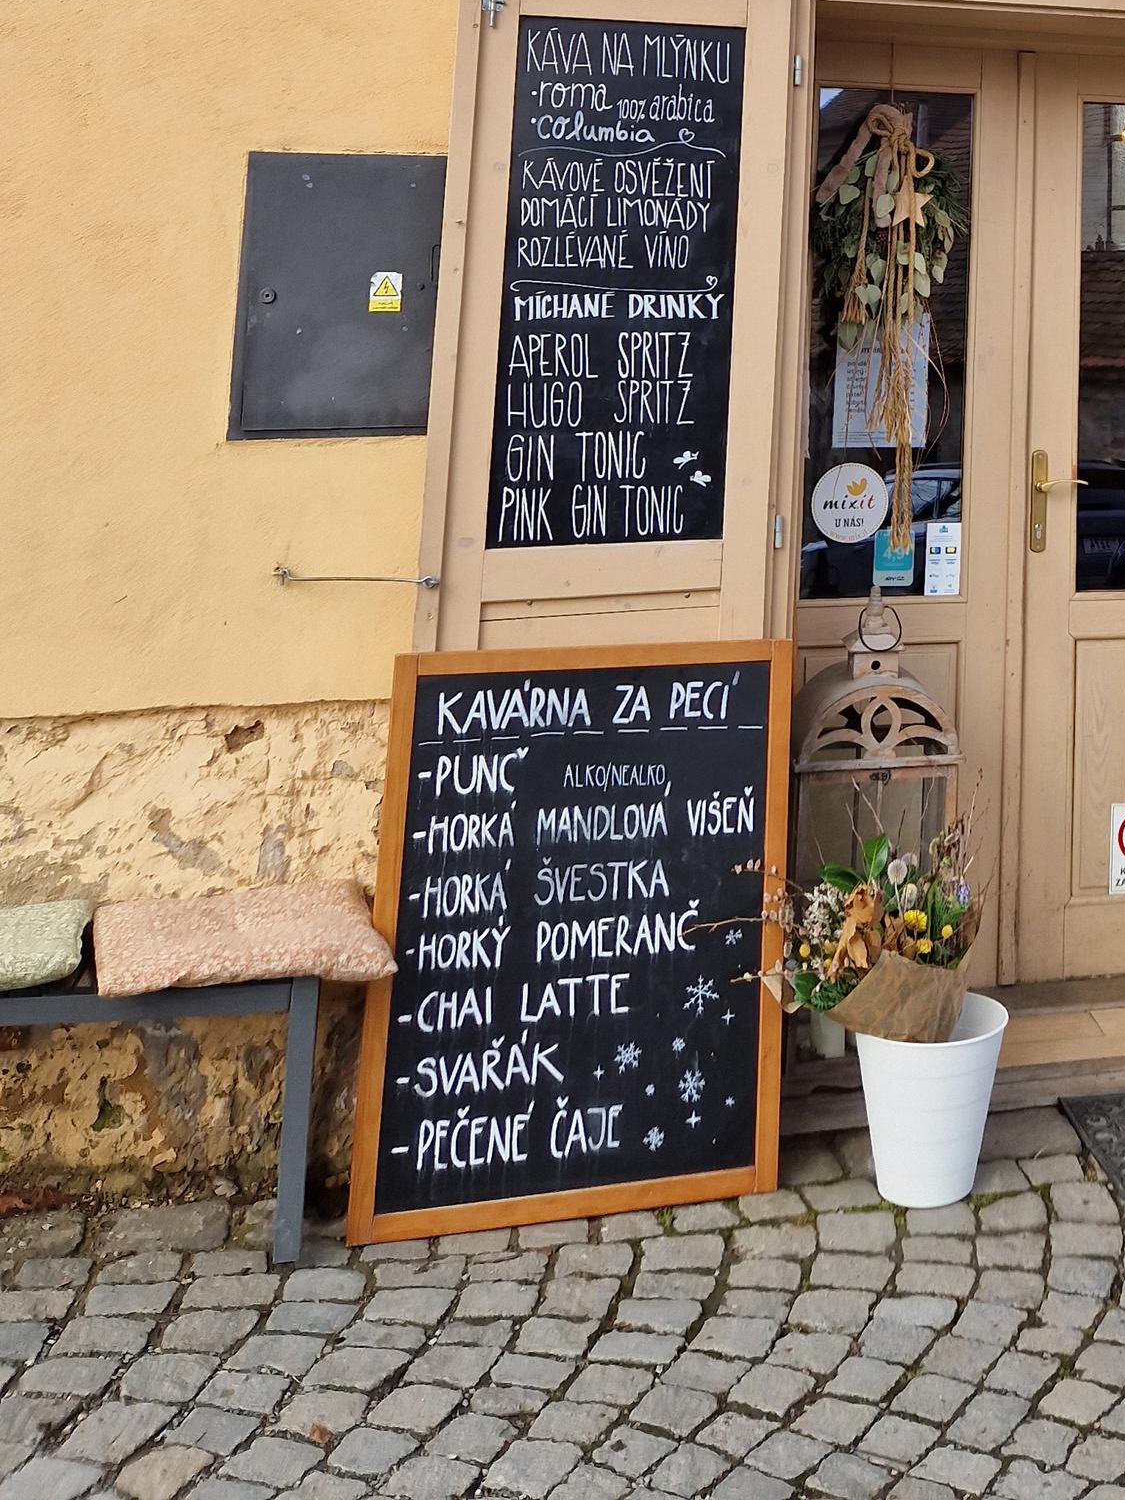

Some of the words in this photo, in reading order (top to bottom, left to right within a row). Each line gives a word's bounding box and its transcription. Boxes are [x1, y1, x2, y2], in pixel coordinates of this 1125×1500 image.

[527, 27, 593, 75] KÁVA
[601, 32, 634, 76] NA
[643, 34, 730, 84] MLÝNKU
[616, 99, 646, 123] 100%
[650, 83, 715, 122] arabica
[522, 157, 605, 193] KÁVOVÉ
[614, 157, 716, 199] OSVĚŽENÍ
[520, 193, 599, 228] DOMÁCÍ
[607, 196, 710, 232] LIMONÁDY
[517, 230, 633, 268] ROZLÉVANÉ
[644, 231, 689, 269] VÍNO
[514, 290, 616, 321] MÍCHANÉ
[628, 293, 725, 319] DRINKY
[508, 333, 599, 379] APEROL
[617, 331, 694, 379] SPRITZ
[507, 381, 583, 429] HUGO
[613, 380, 695, 425] SPRITZ
[506, 434, 554, 482] GIN
[575, 431, 646, 482] TONIC
[498, 486, 553, 542] PINK
[572, 484, 607, 538] GIN
[619, 484, 684, 537] TONIC
[823, 494, 875, 510] mixit
[835, 518, 841, 528] U
[437, 678, 591, 735] KAVÁRNA
[612, 683, 652, 725] ZA
[669, 670, 741, 721] PECÍ
[686, 786, 755, 837] VIŠEŇ
[533, 856, 671, 906] ŠVESTKA
[536, 899, 700, 963] POMERANČ
[520, 972, 631, 1023] LATTE
[550, 1096, 624, 1160] ČAJE
